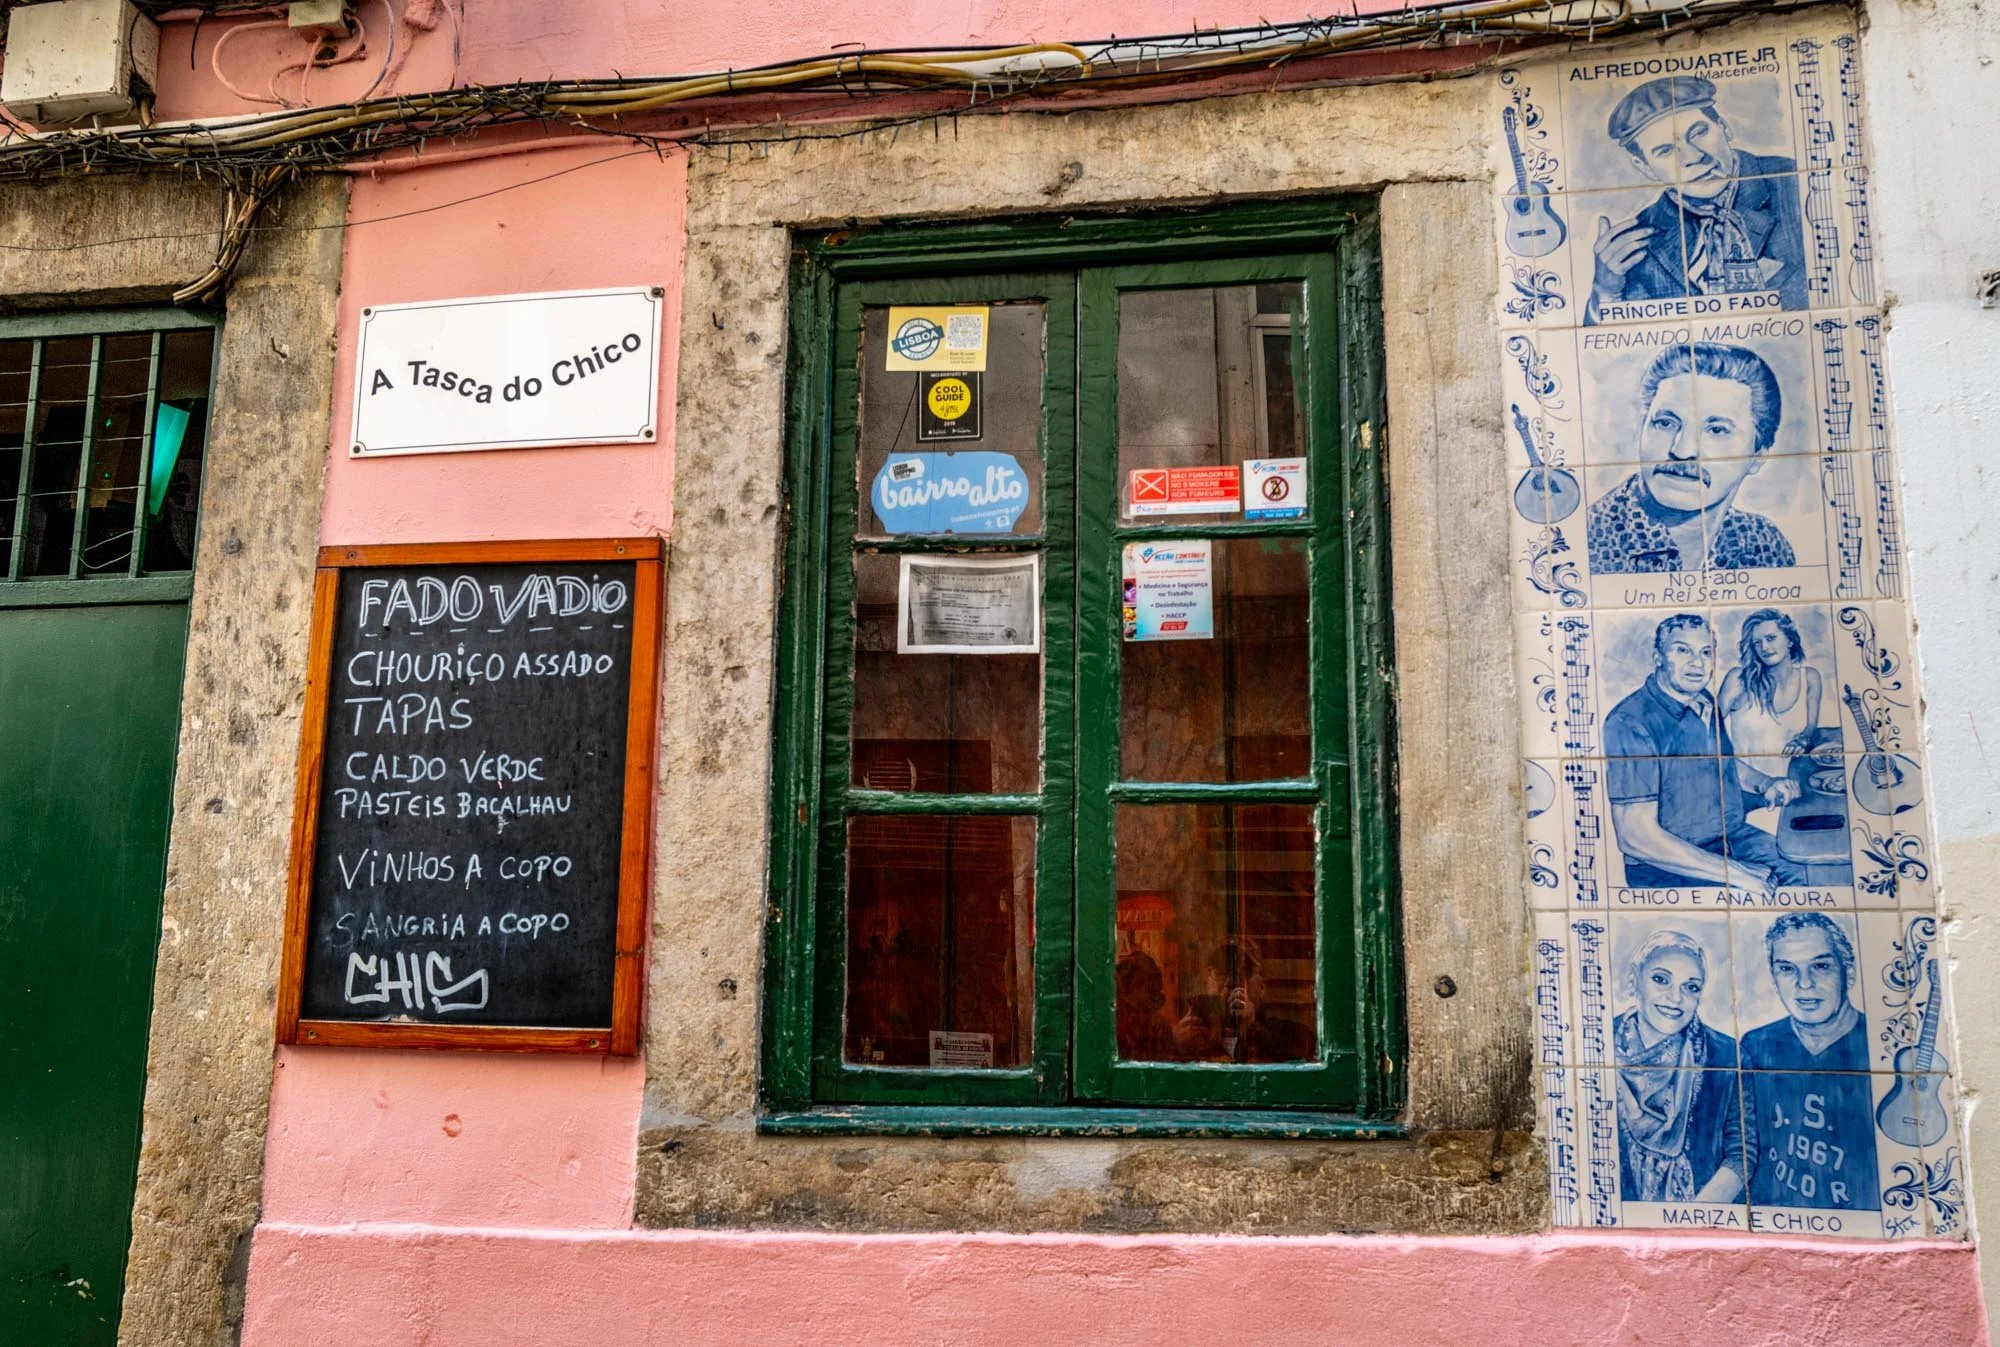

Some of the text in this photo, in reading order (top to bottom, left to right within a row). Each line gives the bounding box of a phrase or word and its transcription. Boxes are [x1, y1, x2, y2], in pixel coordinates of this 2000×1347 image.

[1570, 46, 1776, 81] ALFREDO DUARTE JR
[1694, 61, 1781, 81] (Marceneiro)
[1600, 293, 1780, 322] PRÍNCIPE DO FADO
[899, 330, 939, 348] LISBOA
[1584, 318, 1804, 350] FERNANDO MAURÍCIO
[370, 333, 641, 404] A Tasca do Chico
[935, 385, 964, 393] COOL
[935, 394, 964, 402] GUIDE
[880, 465, 1023, 510] bairro alto
[1188, 470, 1234, 479] FUMADORES
[1669, 570, 1750, 588] No Fado
[359, 575, 484, 628] FADO
[1624, 585, 1801, 605] Um Rei Sem Coroa
[513, 651, 613, 679] ASSADO
[344, 693, 472, 736] TAPAS
[346, 750, 544, 784] CALDO VERDE
[465, 854, 483, 885] A
[499, 856, 572, 882] COPO
[1618, 888, 1837, 908] CHICO E ANA MOURA
[478, 913, 492, 936] A
[499, 912, 570, 940] COPO
[1803, 1093, 1833, 1131] S.
[1788, 1133, 1844, 1171] 1967
[1663, 1209, 1842, 1233] MARIZA E CHICO
